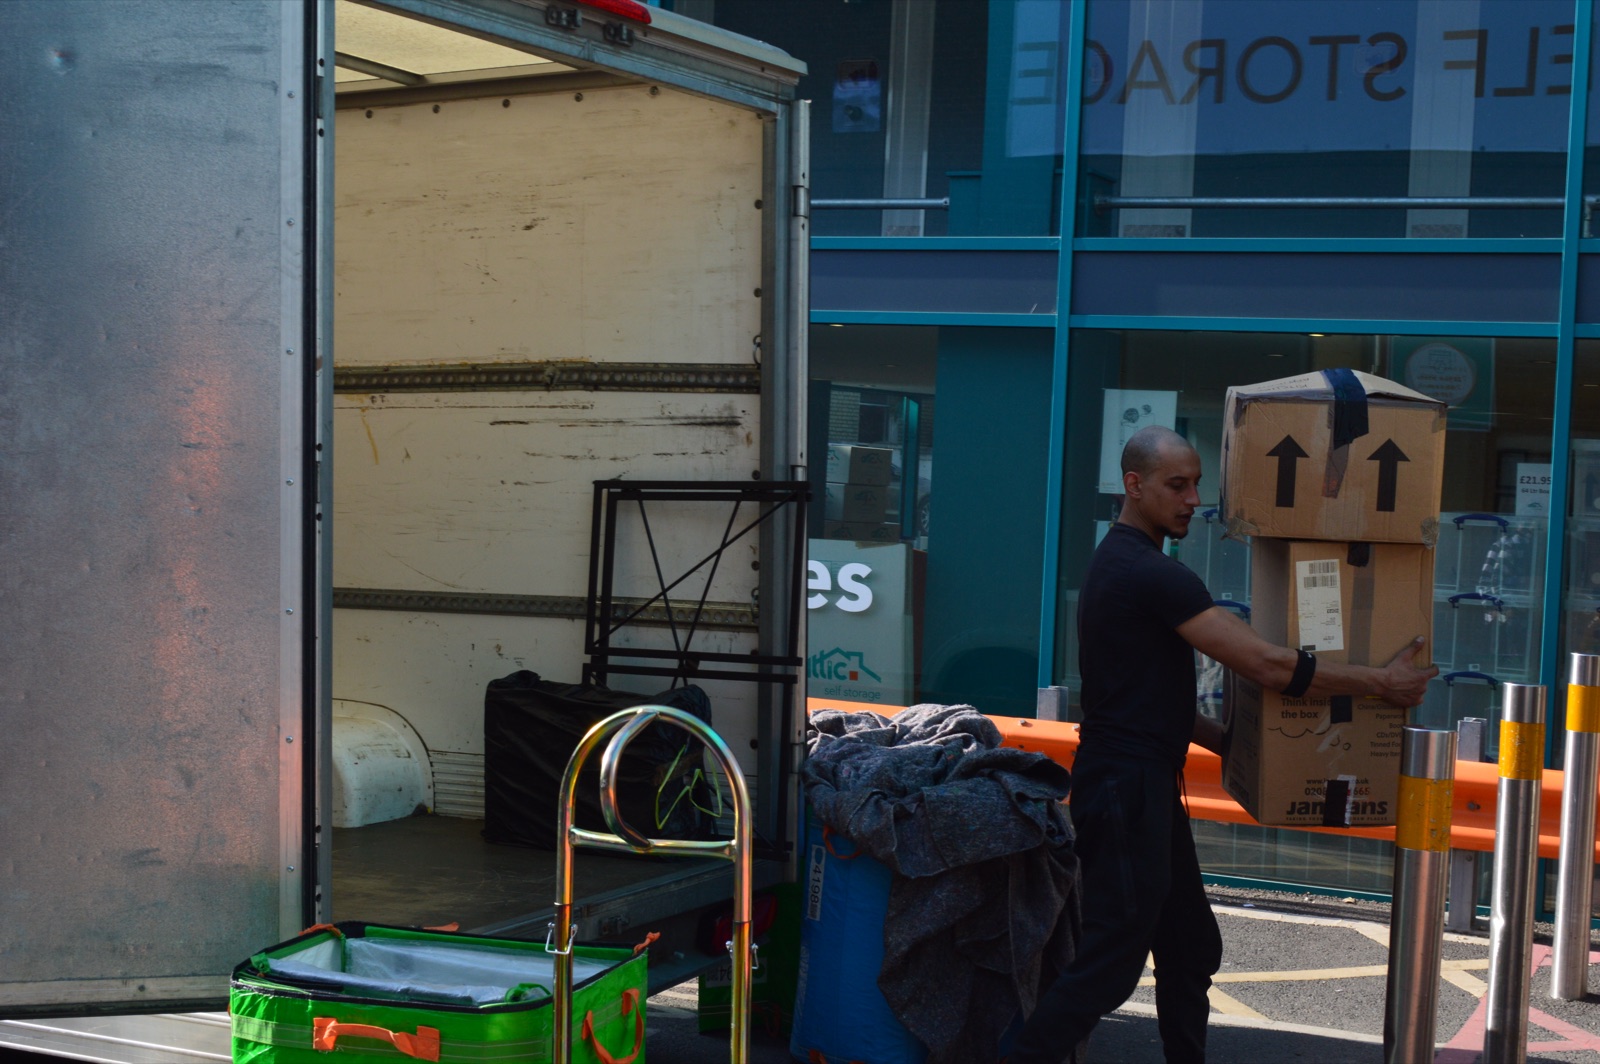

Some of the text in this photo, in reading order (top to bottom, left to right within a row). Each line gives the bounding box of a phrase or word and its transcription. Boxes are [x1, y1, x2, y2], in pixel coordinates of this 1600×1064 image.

[824, 685, 881, 701] self storage
[1281, 697, 1308, 707] Think
[1281, 710, 1319, 719] the box
[1375, 713, 1402, 721] Paperwo
[810, 864, 822, 904] 4198
